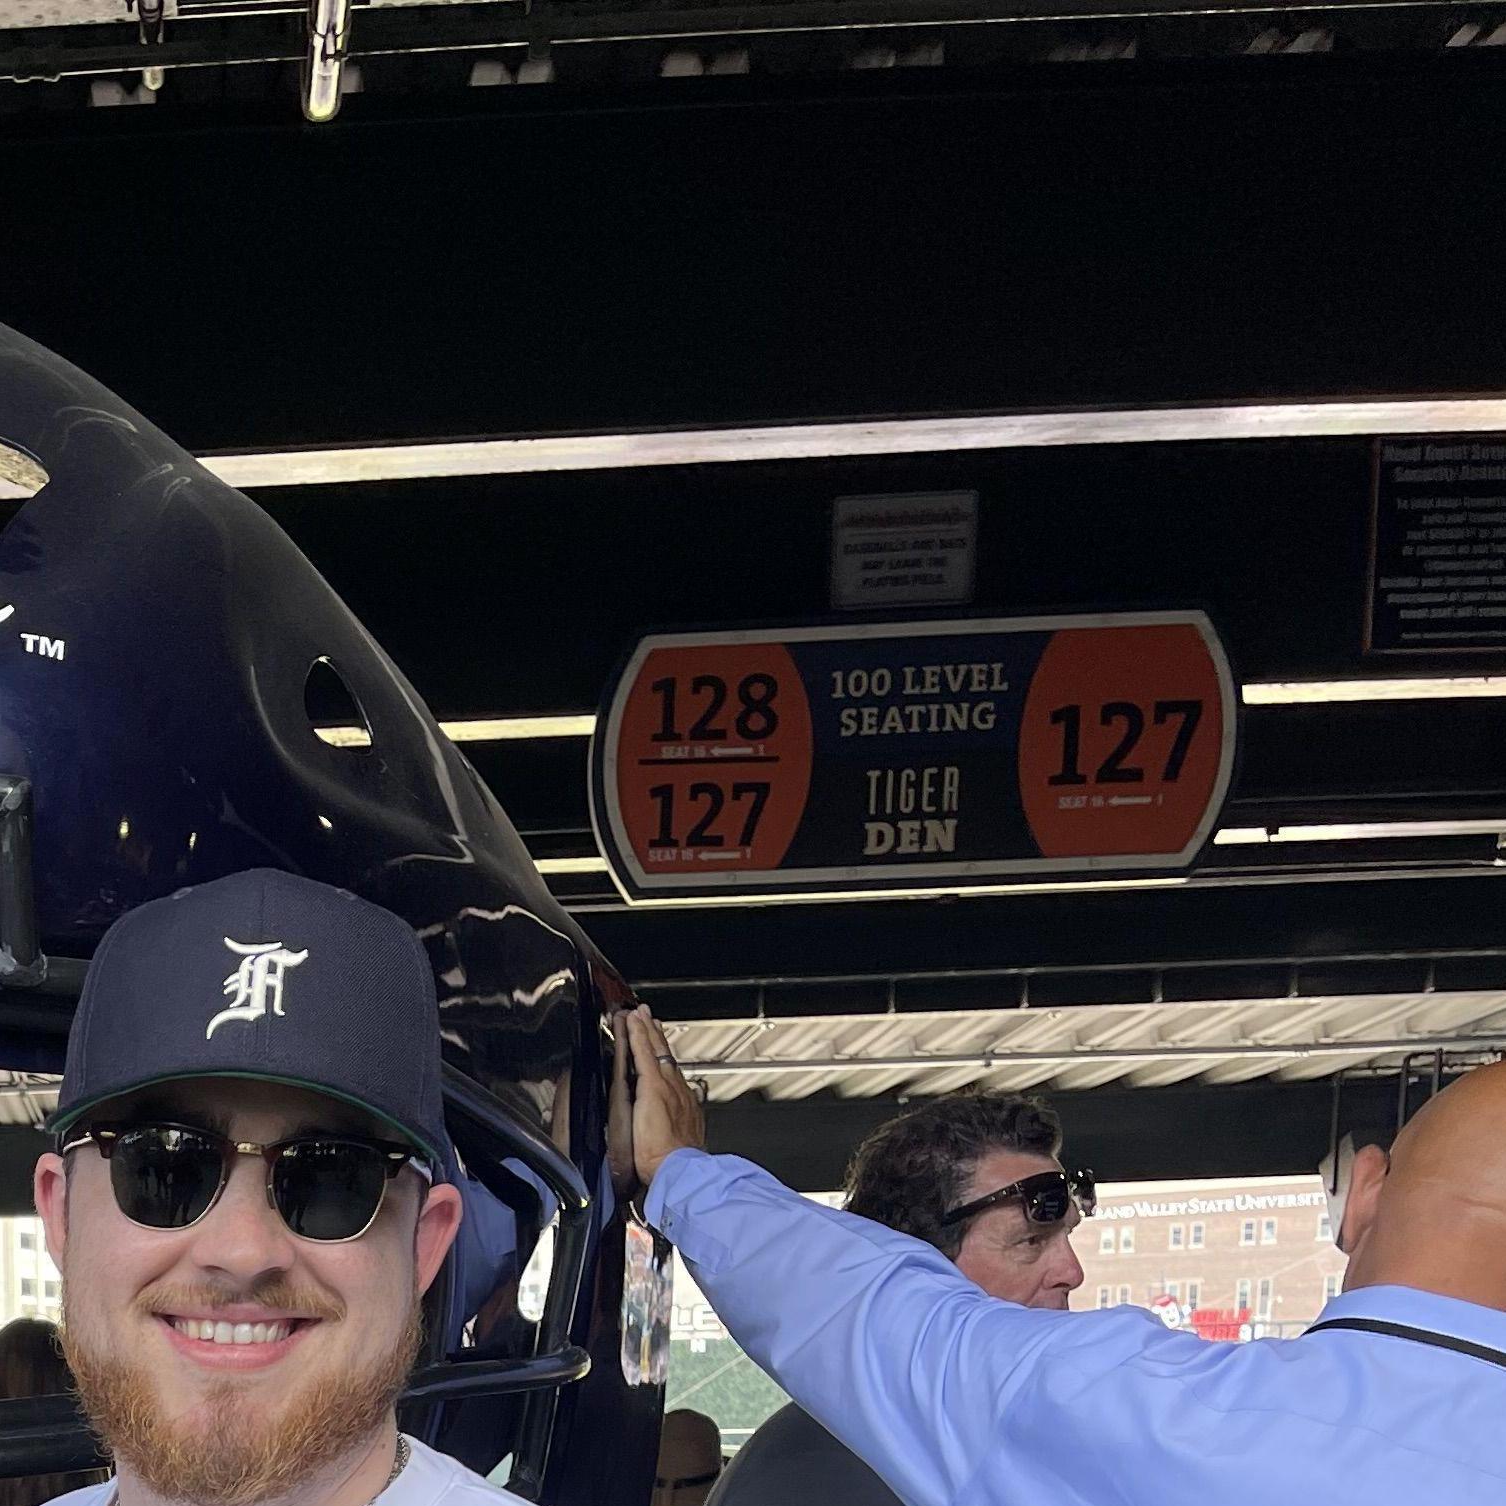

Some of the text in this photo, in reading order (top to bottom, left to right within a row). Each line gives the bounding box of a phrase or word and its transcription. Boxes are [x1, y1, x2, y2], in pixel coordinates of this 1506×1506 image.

[20, 632, 65, 661] TM
[831, 662, 1010, 699] 100 LEVEL
[651, 673, 779, 742] 128
[840, 701, 997, 738] SEATING
[1048, 700, 1203, 786] 127
[866, 766, 960, 816] TIGER
[648, 782, 771, 848] 127
[863, 818, 958, 857] DEN
[1134, 1200, 1187, 1218] VALLEY
[1187, 1197, 1235, 1214] STATE
